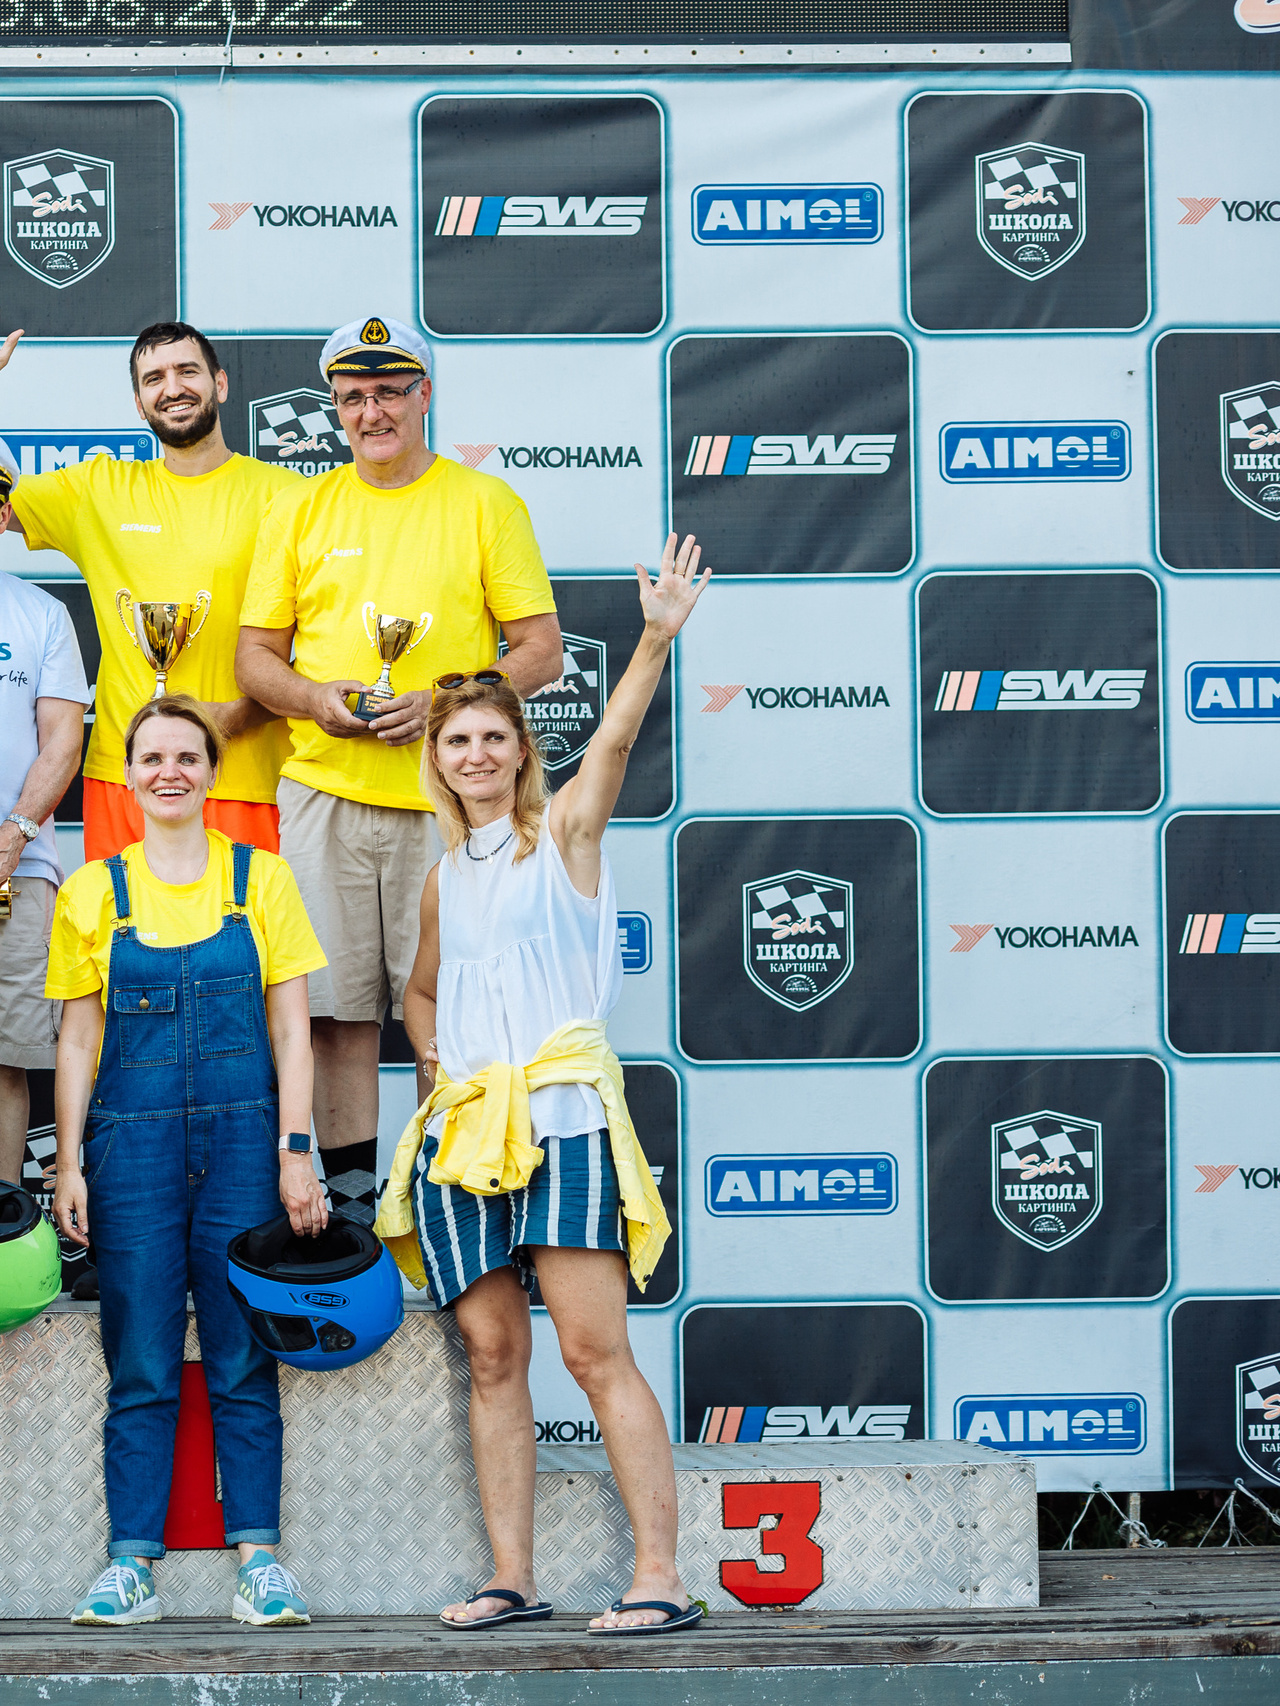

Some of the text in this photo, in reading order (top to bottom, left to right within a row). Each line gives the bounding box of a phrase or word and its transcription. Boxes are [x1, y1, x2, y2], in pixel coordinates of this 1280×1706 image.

[32, 192, 87, 218] Sodi
[1004, 184, 1059, 211] Sodi
[253, 205, 398, 228] YOKOHAMA
[989, 213, 1073, 231] ШКОЛА
[17, 221, 101, 239] ШКОЛА
[1002, 231, 1060, 243] КАРТИНГА
[30, 239, 89, 251] КАРТИНГА
[278, 431, 333, 457] Sodi
[499, 446, 643, 469] YOKOHAMA
[119, 523, 163, 534] SIEMENS
[9, 670, 29, 687] life
[746, 686, 890, 709] YOKOHAMA
[771, 913, 826, 940] Sodi
[994, 926, 1139, 949] YOKOHAMA
[756, 943, 841, 960] ШКОЛА
[770, 962, 828, 973] КАРТИНГА
[1020, 1154, 1074, 1181] Sodi
[1004, 1183, 1089, 1201] ШКОЛА
[1018, 1201, 1077, 1213] КАРТИНГА
[719, 1481, 824, 1606] 3
